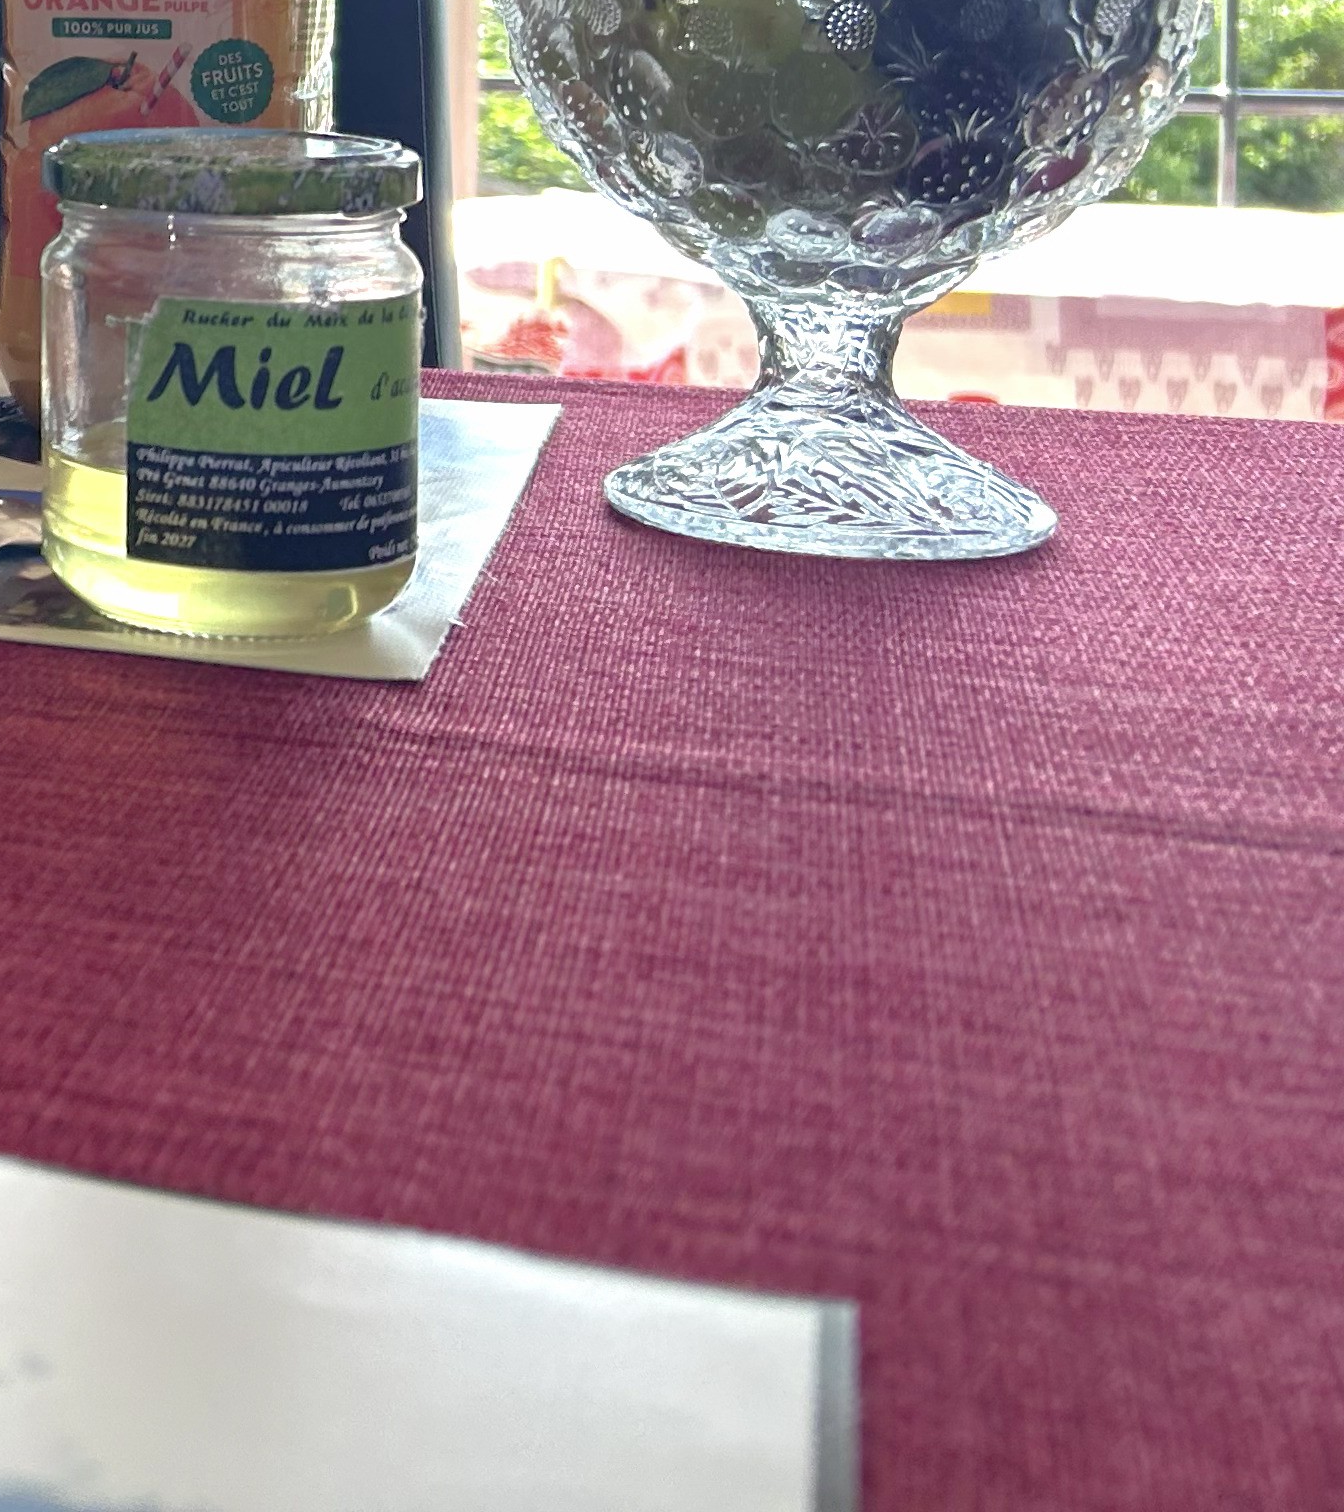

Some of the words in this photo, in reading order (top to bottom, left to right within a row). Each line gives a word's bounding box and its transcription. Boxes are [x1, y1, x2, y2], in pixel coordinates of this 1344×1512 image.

[164, 0, 208, 13] PULPE
[64, 21, 103, 36] 100%
[107, 21, 132, 35] PUR
[136, 21, 159, 36] JUS
[218, 51, 243, 67] DES
[201, 62, 263, 87] FRUITS
[211, 88, 224, 101] ET
[221, 97, 255, 114] TOUT
[182, 308, 255, 328] Rucher
[266, 310, 292, 328] du
[146, 342, 345, 410] Miel
